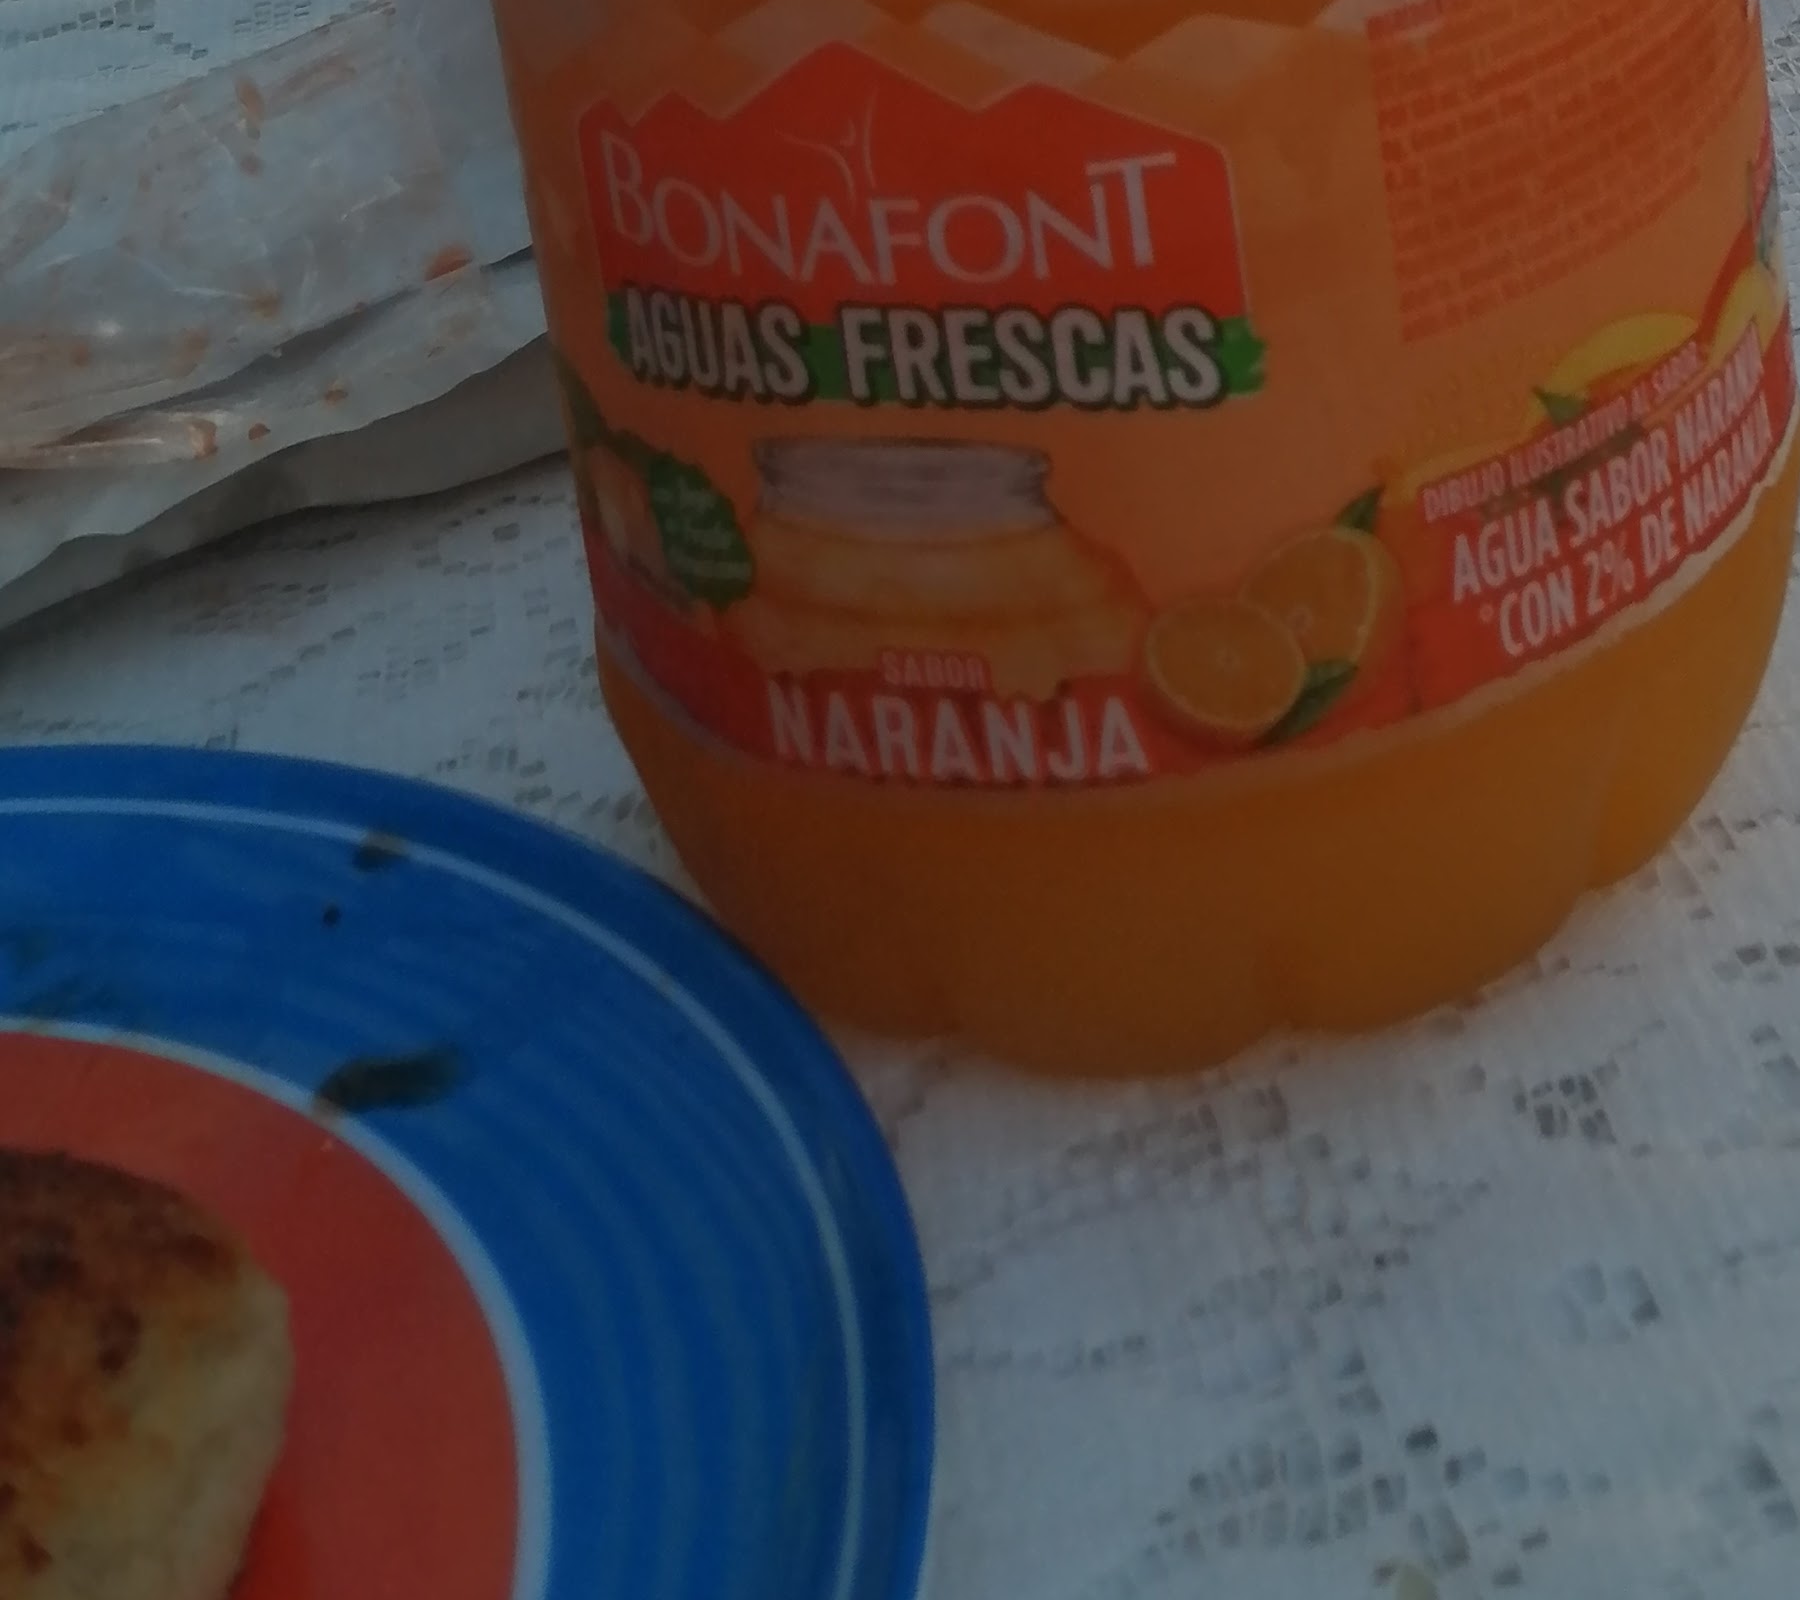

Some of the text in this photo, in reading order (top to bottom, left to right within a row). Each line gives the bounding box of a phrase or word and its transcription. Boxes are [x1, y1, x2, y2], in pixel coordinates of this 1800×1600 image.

[600, 128, 1177, 287] BONAFONT
[624, 286, 1224, 405] AGUAS FRESCAS
[1423, 460, 1506, 524] DIBUJO
[1452, 498, 1561, 605] AGUA
[1564, 428, 1674, 549] SABOR
[1499, 390, 1774, 658] CON 2% DE NARANJA
[882, 649, 986, 690] SABOR
[767, 677, 1151, 785] NARANJA
